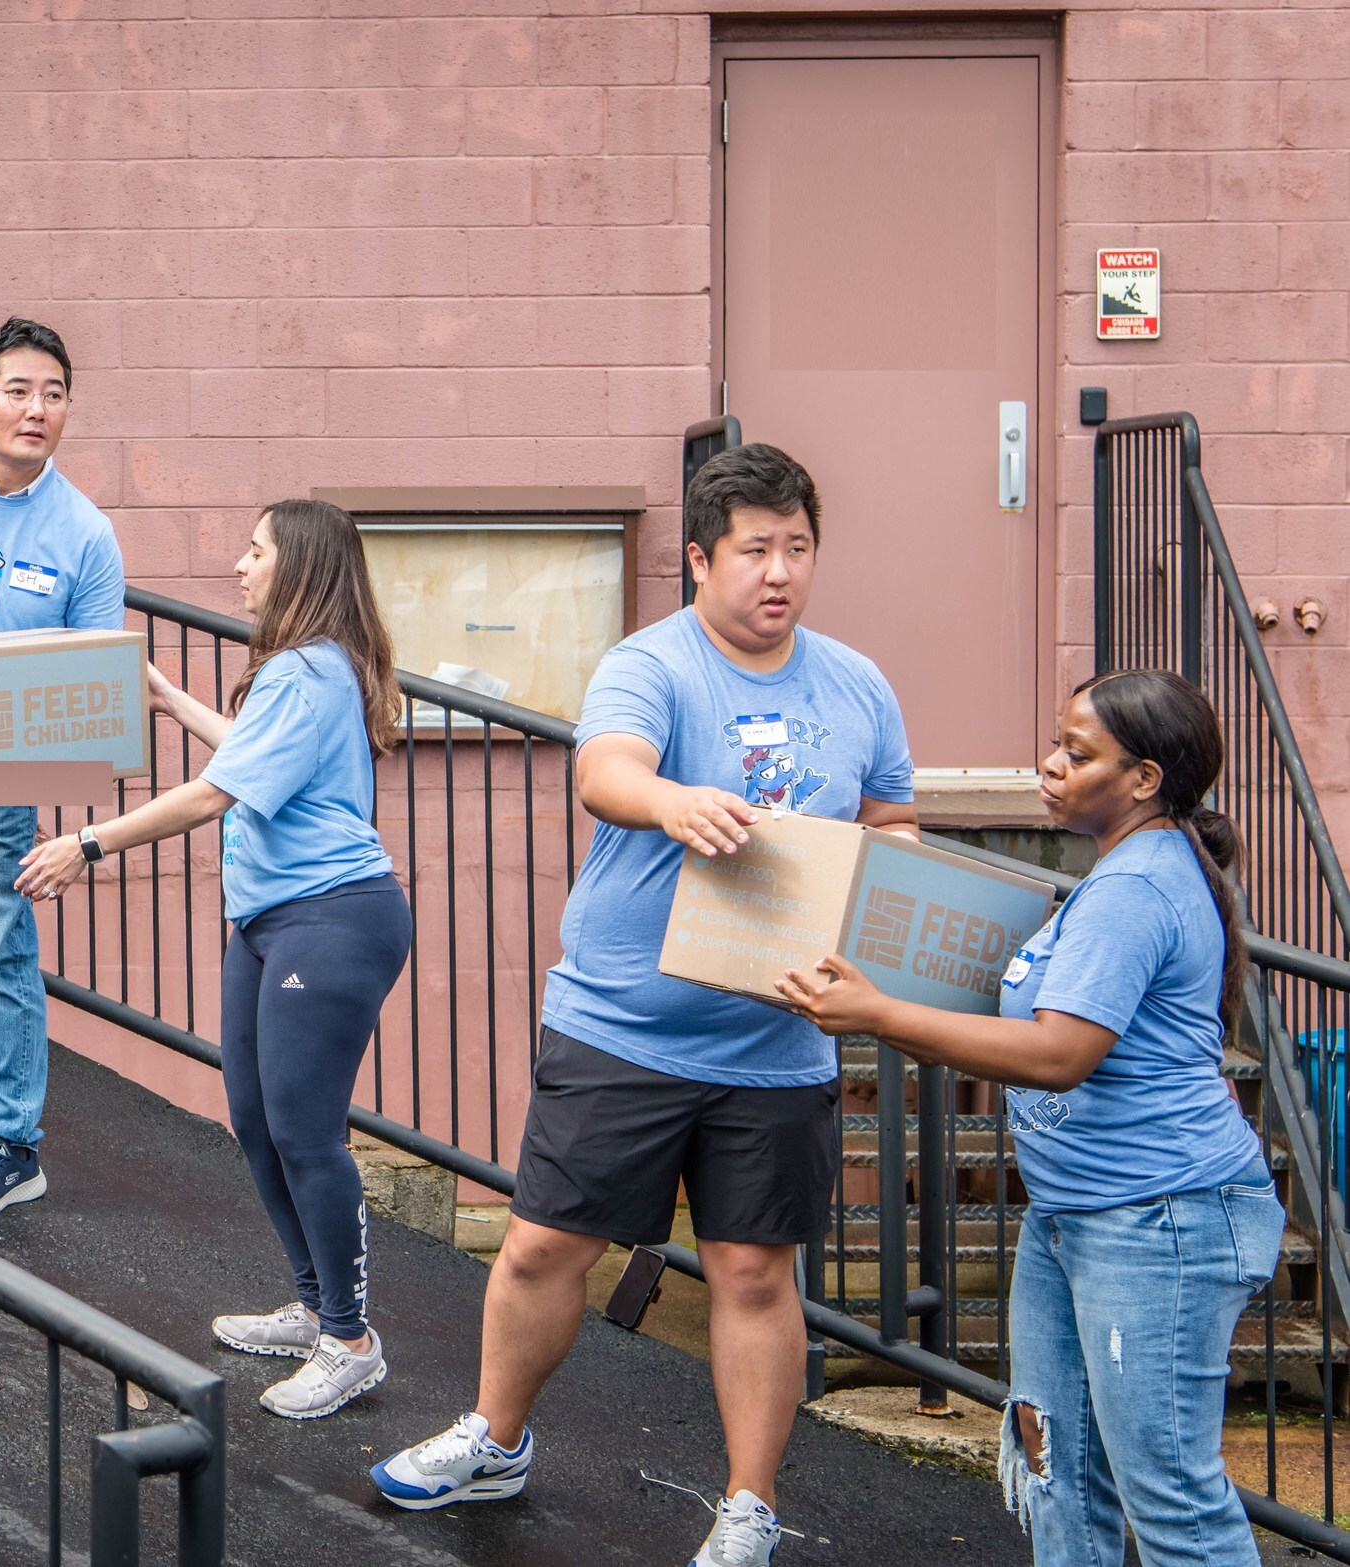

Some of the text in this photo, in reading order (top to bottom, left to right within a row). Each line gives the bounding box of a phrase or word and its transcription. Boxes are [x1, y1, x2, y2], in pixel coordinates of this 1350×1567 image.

[1102, 270, 1156, 278] YOUR STEP
[1105, 253, 1153, 267] WATCH
[1106, 326, 1150, 335] DONDE PISA
[1111, 318, 1145, 326] CUIDADO
[23, 680, 109, 723] FEED
[111, 679, 123, 713] THE
[723, 718, 831, 750] SRY
[764, 841, 807, 859] WATER
[710, 859, 775, 882] GIVE FOOD
[705, 884, 811, 916] INSPIRE PROGRESS
[699, 909, 830, 947] BESTOW KNOWLEDGE
[919, 902, 1006, 965] FEED
[693, 933, 806, 968] SUPPORT WITH AID
